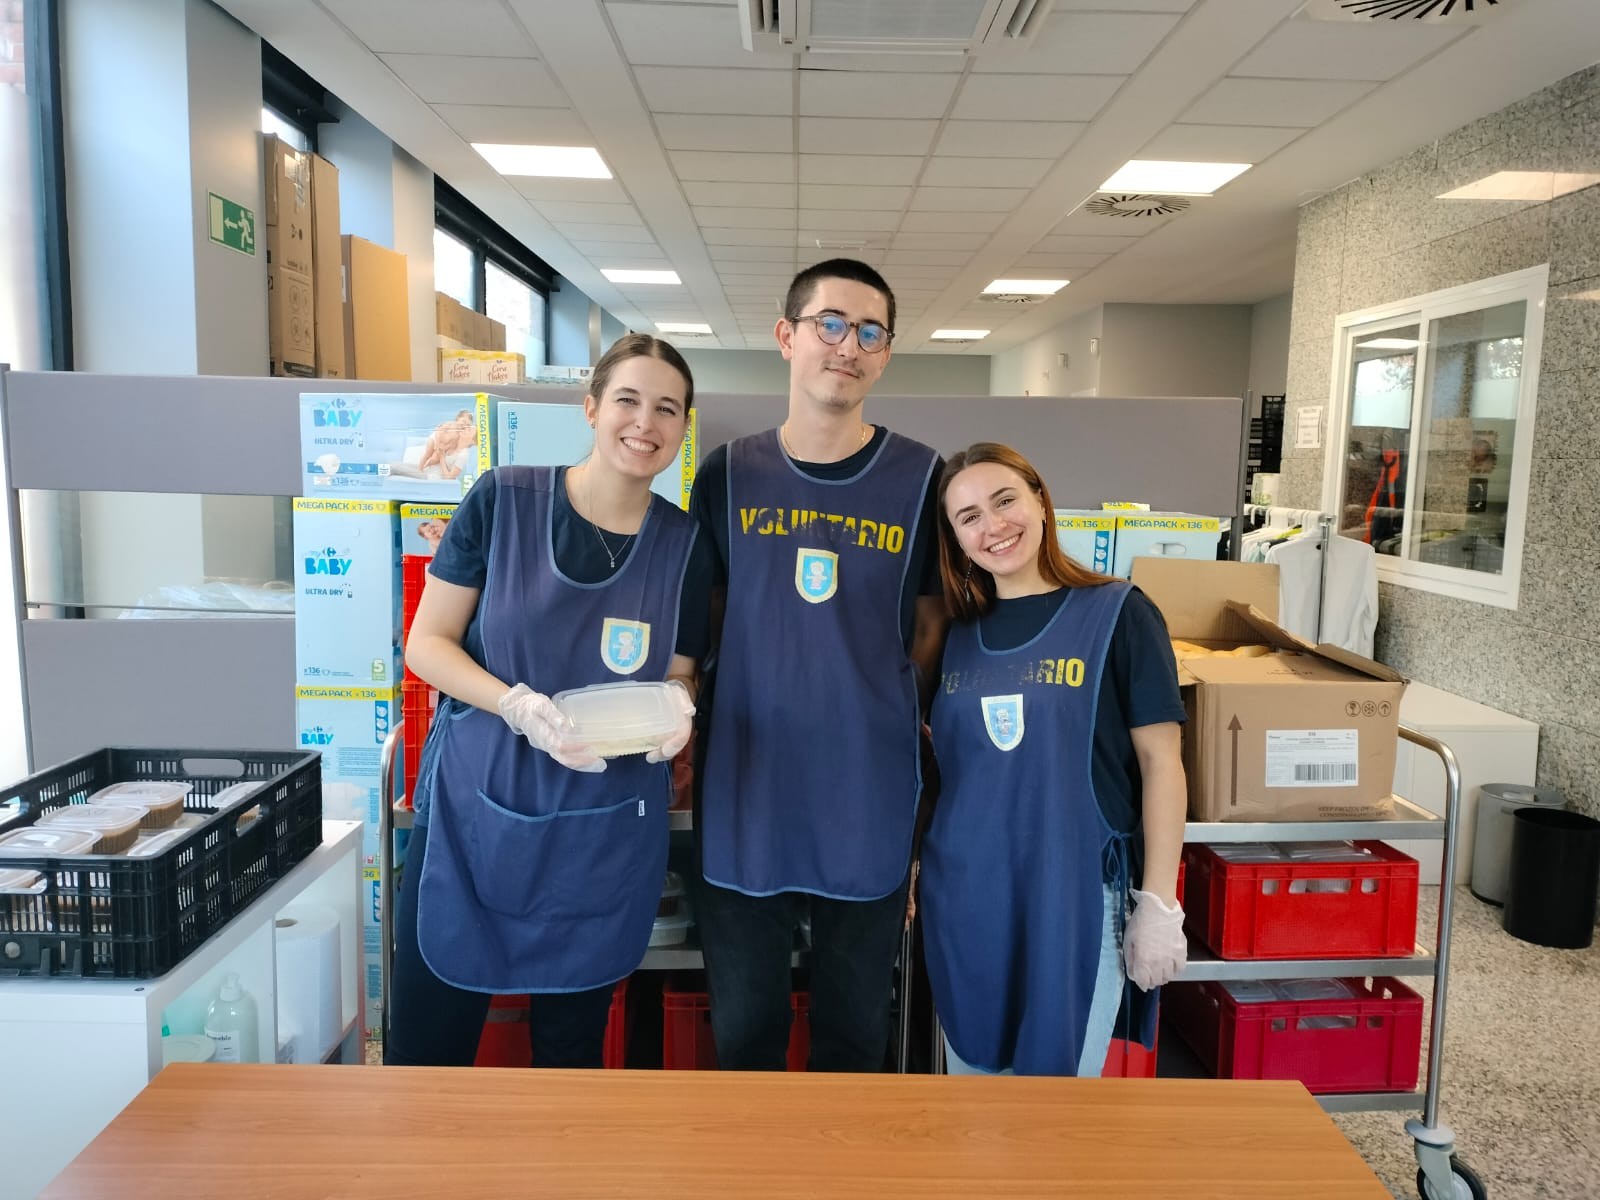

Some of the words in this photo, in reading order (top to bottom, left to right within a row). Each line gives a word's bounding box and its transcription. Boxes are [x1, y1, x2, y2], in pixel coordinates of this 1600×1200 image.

[313, 409, 363, 428] BABY
[314, 437, 338, 445] ULTRA
[339, 438, 355, 446] DRY
[297, 501, 324, 509] MEGA
[325, 502, 350, 510] PACK
[358, 503, 374, 511] 136
[410, 508, 438, 516] MEGA
[1056, 519, 1073, 528] ACK
[1124, 519, 1152, 527] MEGA
[1153, 520, 1178, 529] PACK
[304, 557, 353, 576] BABY
[305, 587, 328, 596] ULTRA
[329, 588, 344, 596] DRY
[373, 659, 384, 673] 5
[300, 689, 328, 697] MEGA
[301, 733, 334, 745] BABY
[363, 870, 375, 878] 36
